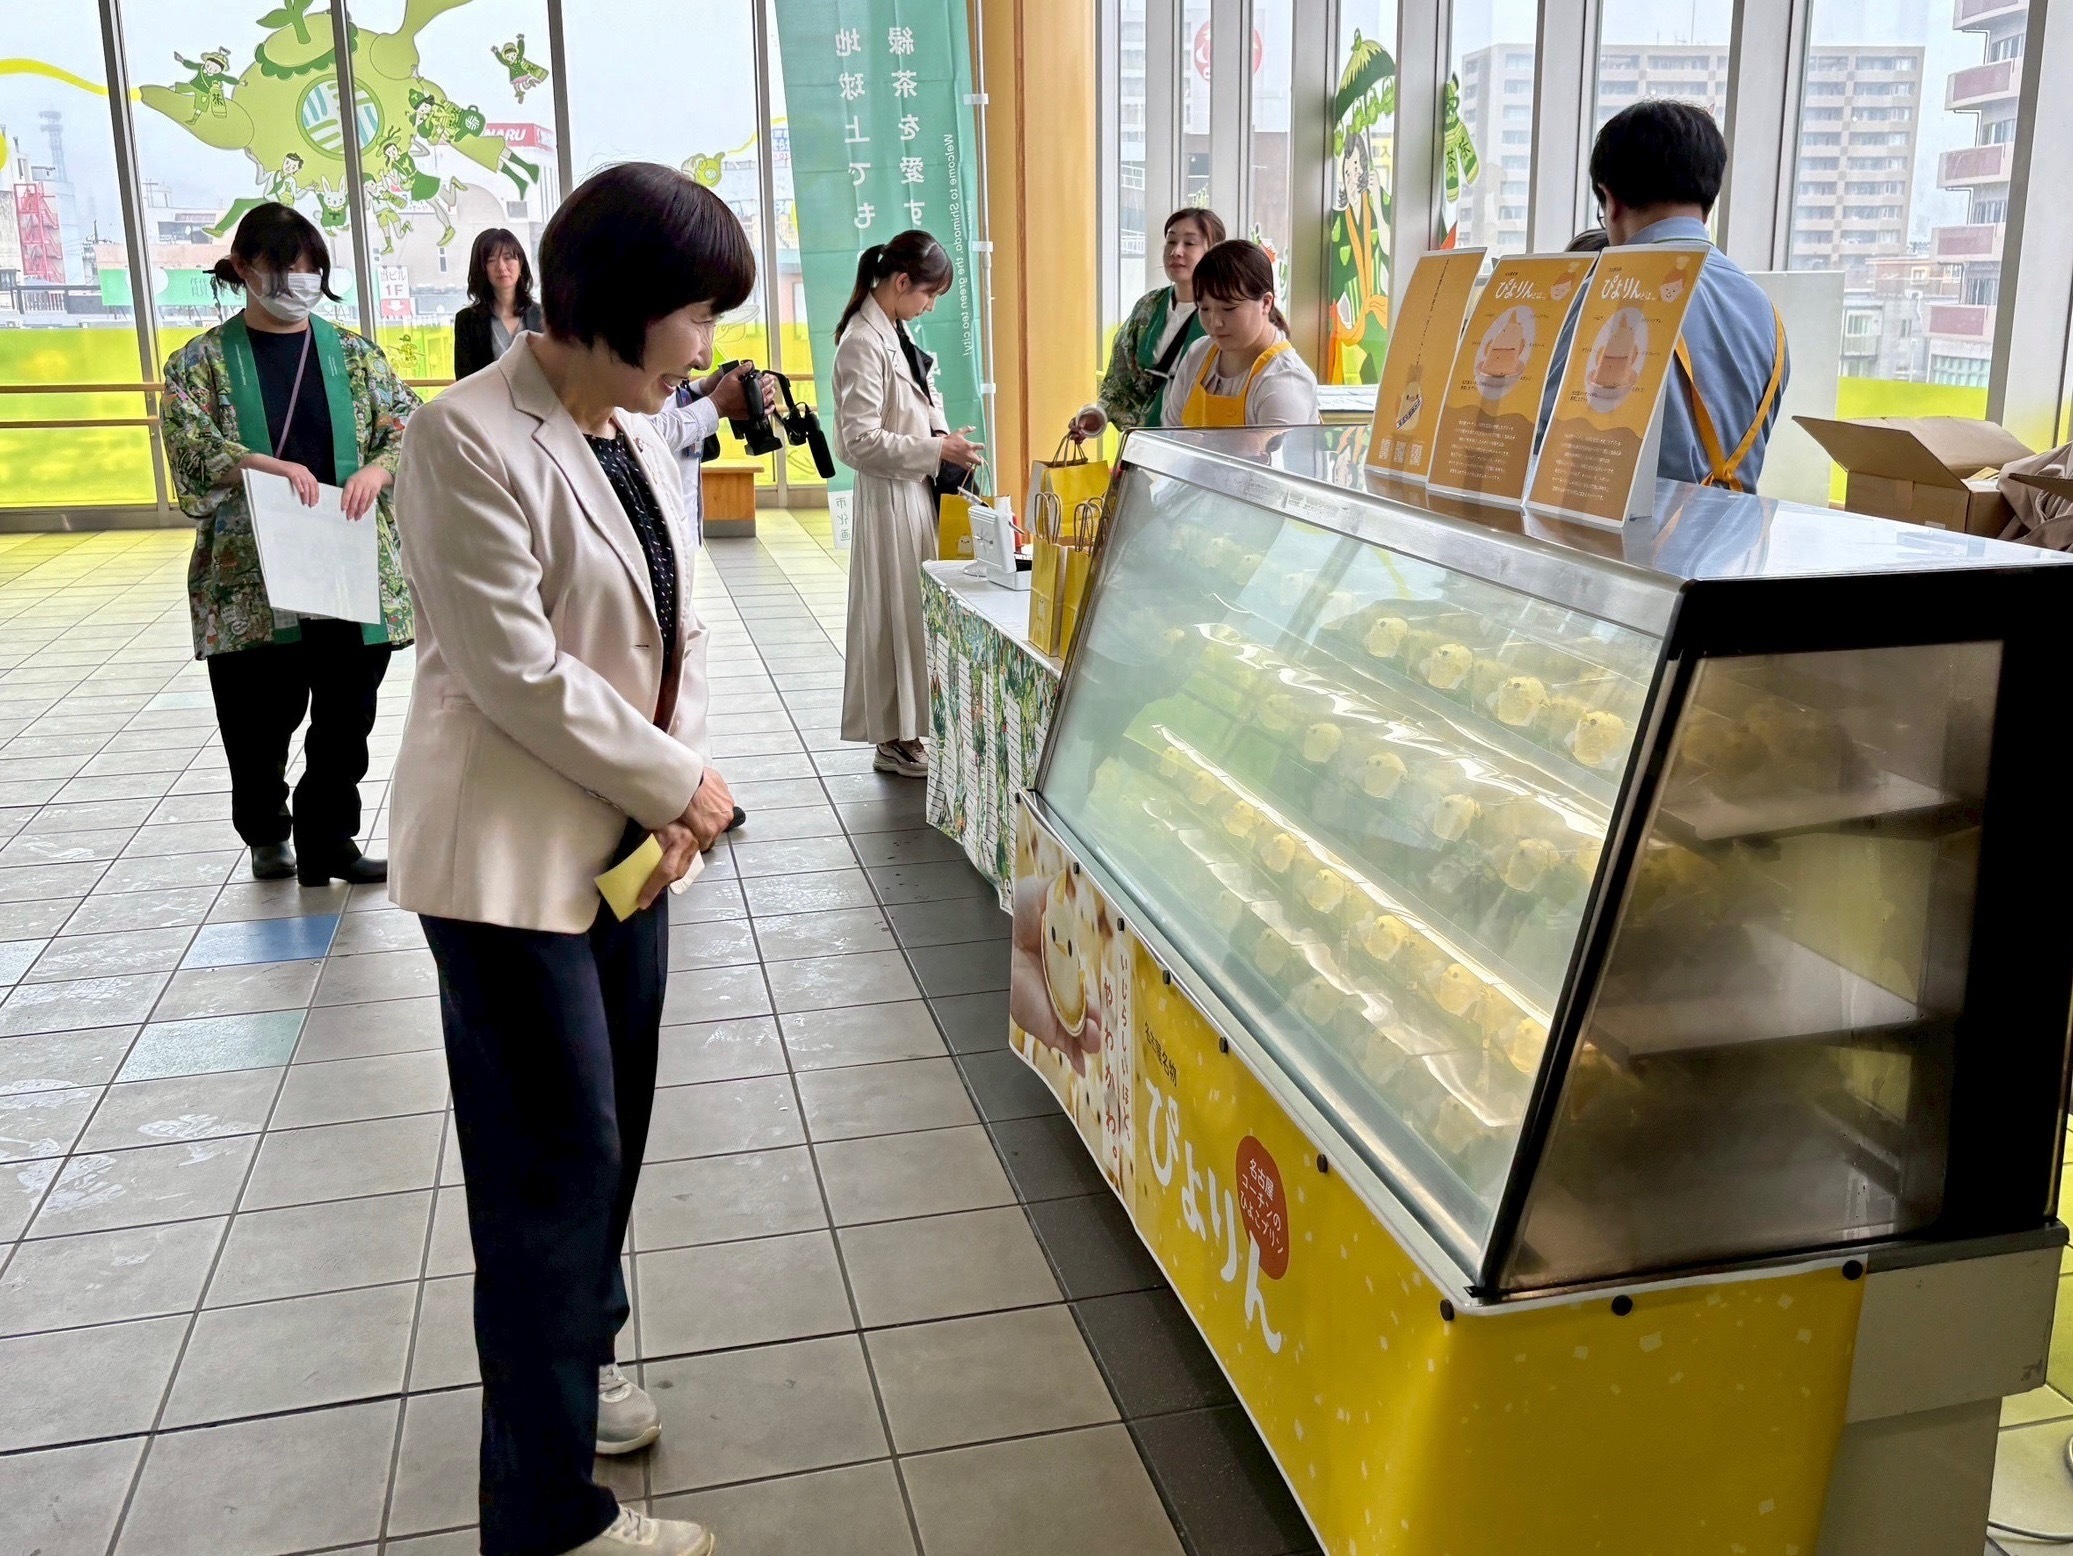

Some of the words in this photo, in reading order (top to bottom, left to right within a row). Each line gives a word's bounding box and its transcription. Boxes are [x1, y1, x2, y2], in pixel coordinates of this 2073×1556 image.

[385, 285, 403, 296] 1F
[1104, 977, 1119, 1159] やわかわ。
[1144, 1020, 1177, 1088] 名古屋名物
[1241, 1173, 1281, 1232] コーチンの
[1249, 1158, 1275, 1201] 名古屋
[1145, 1077, 1283, 1355] ぴよりん
[1240, 1190, 1284, 1255] ひよこプリン
